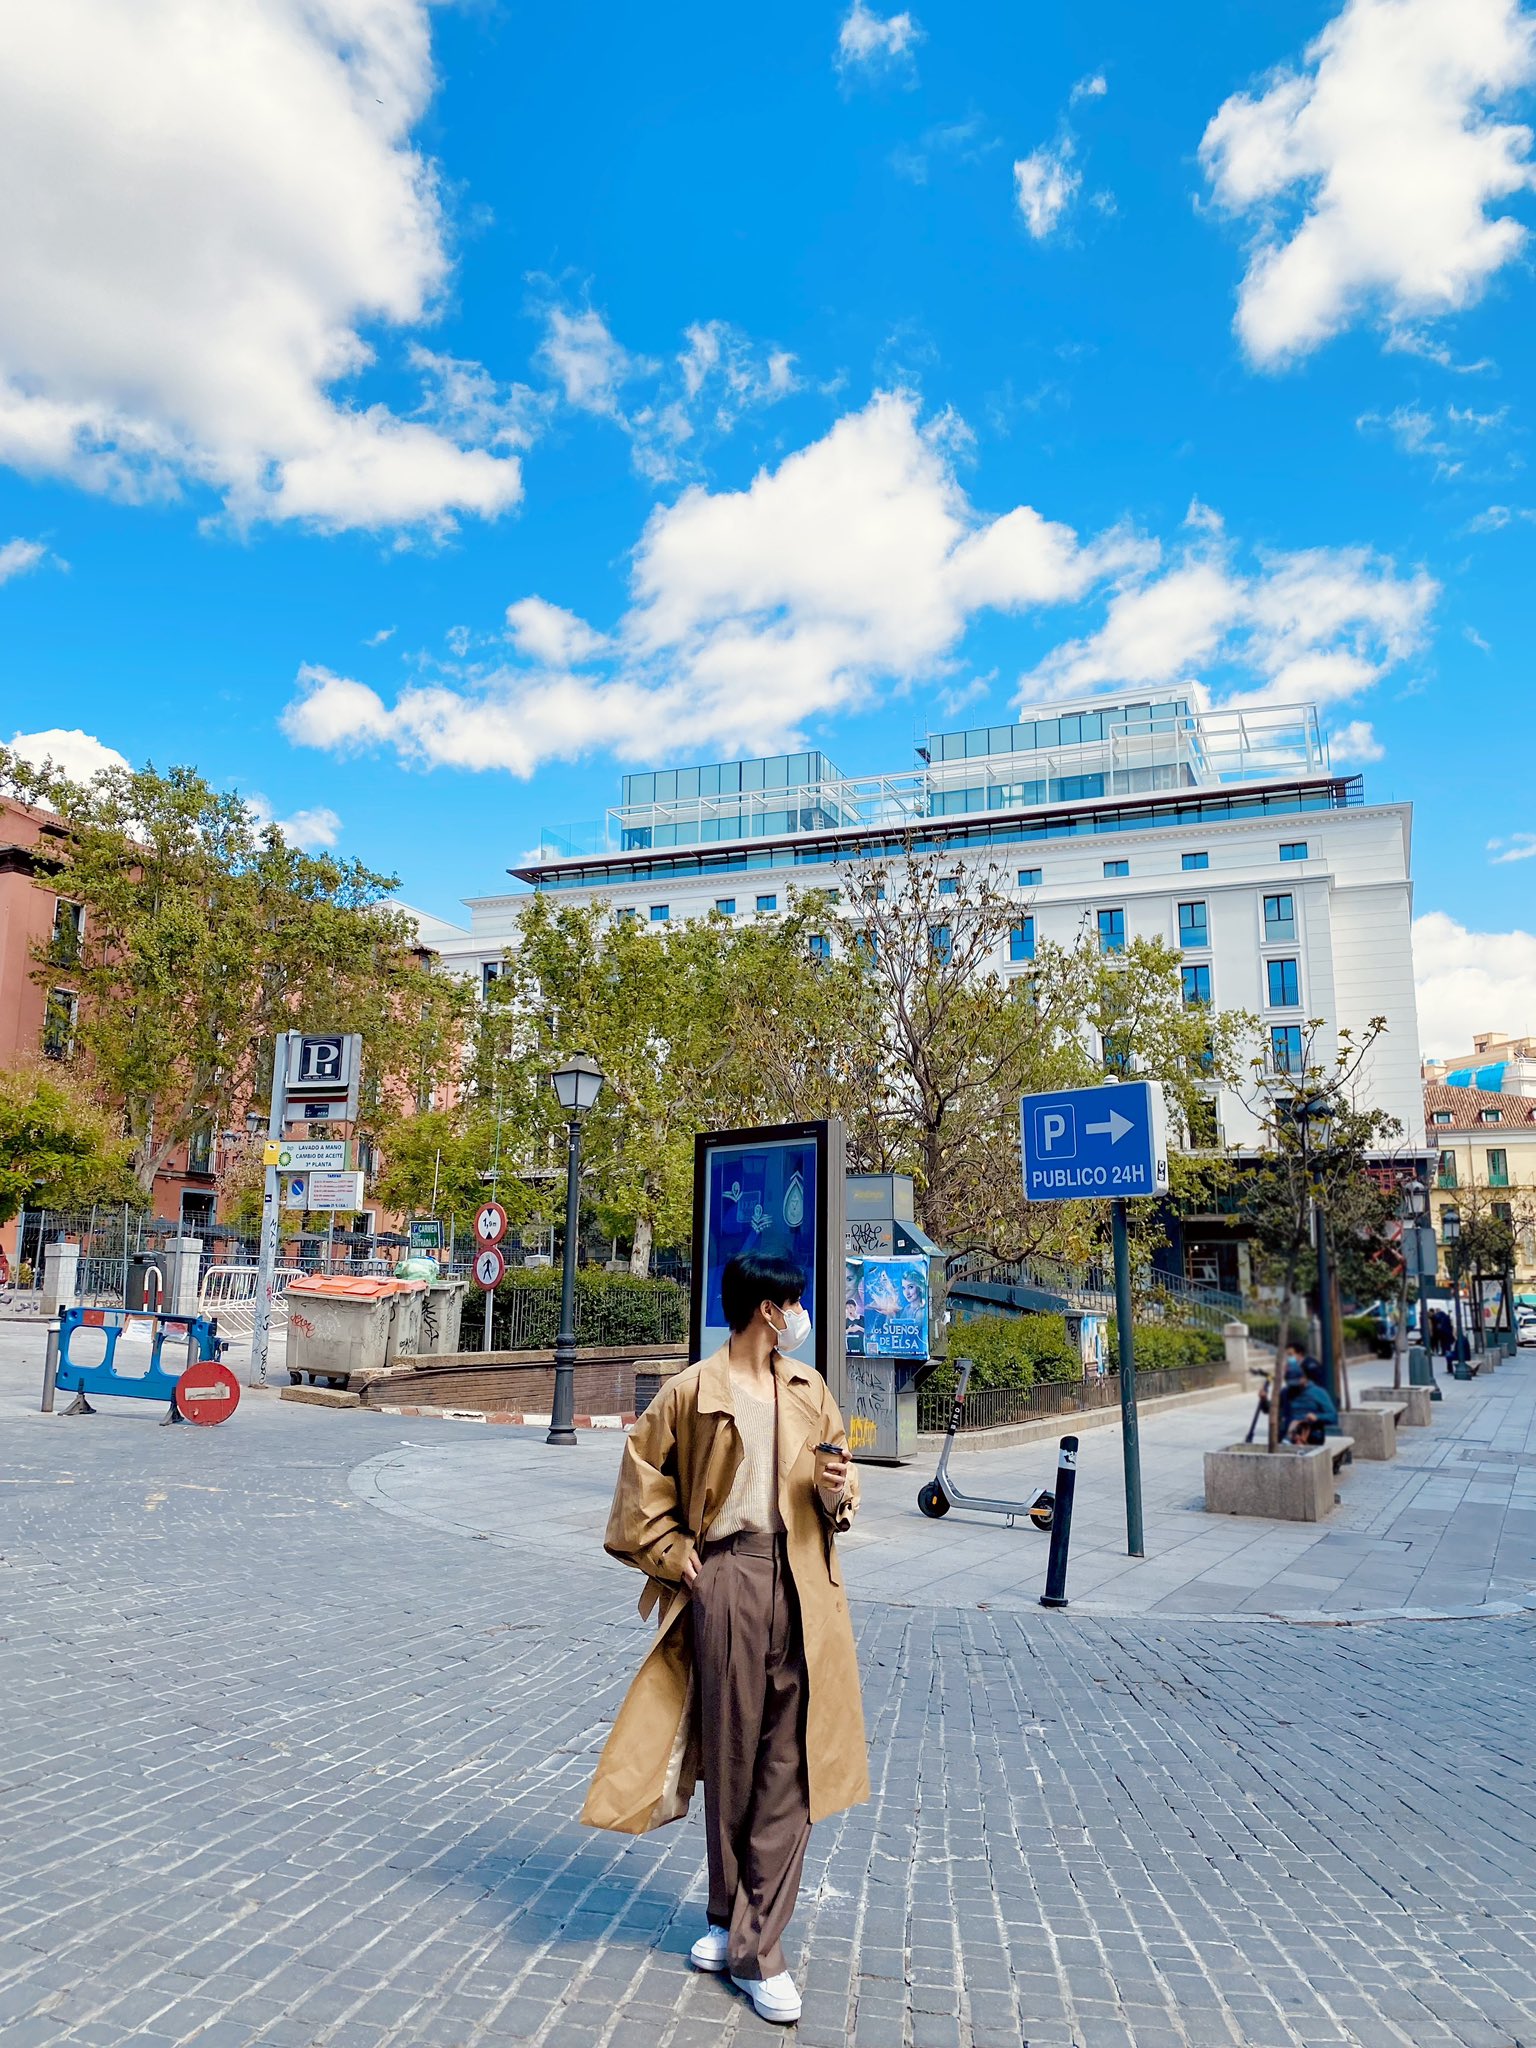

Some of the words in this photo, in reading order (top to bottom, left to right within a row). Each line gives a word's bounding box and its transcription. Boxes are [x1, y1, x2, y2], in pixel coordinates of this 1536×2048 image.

[303, 1044, 339, 1077] P
[1044, 1114, 1066, 1151] P
[570, 1143, 575, 1151] 2
[1032, 1166, 1107, 1188] PUBLICO
[1112, 1164, 1145, 1184] 24H
[419, 1224, 438, 1233] CARMEN
[412, 1238, 432, 1248] ENTRADA
[880, 1337, 891, 1346] DE
[892, 1335, 919, 1349] ELSA
[950, 1407, 961, 1430] BIRD
